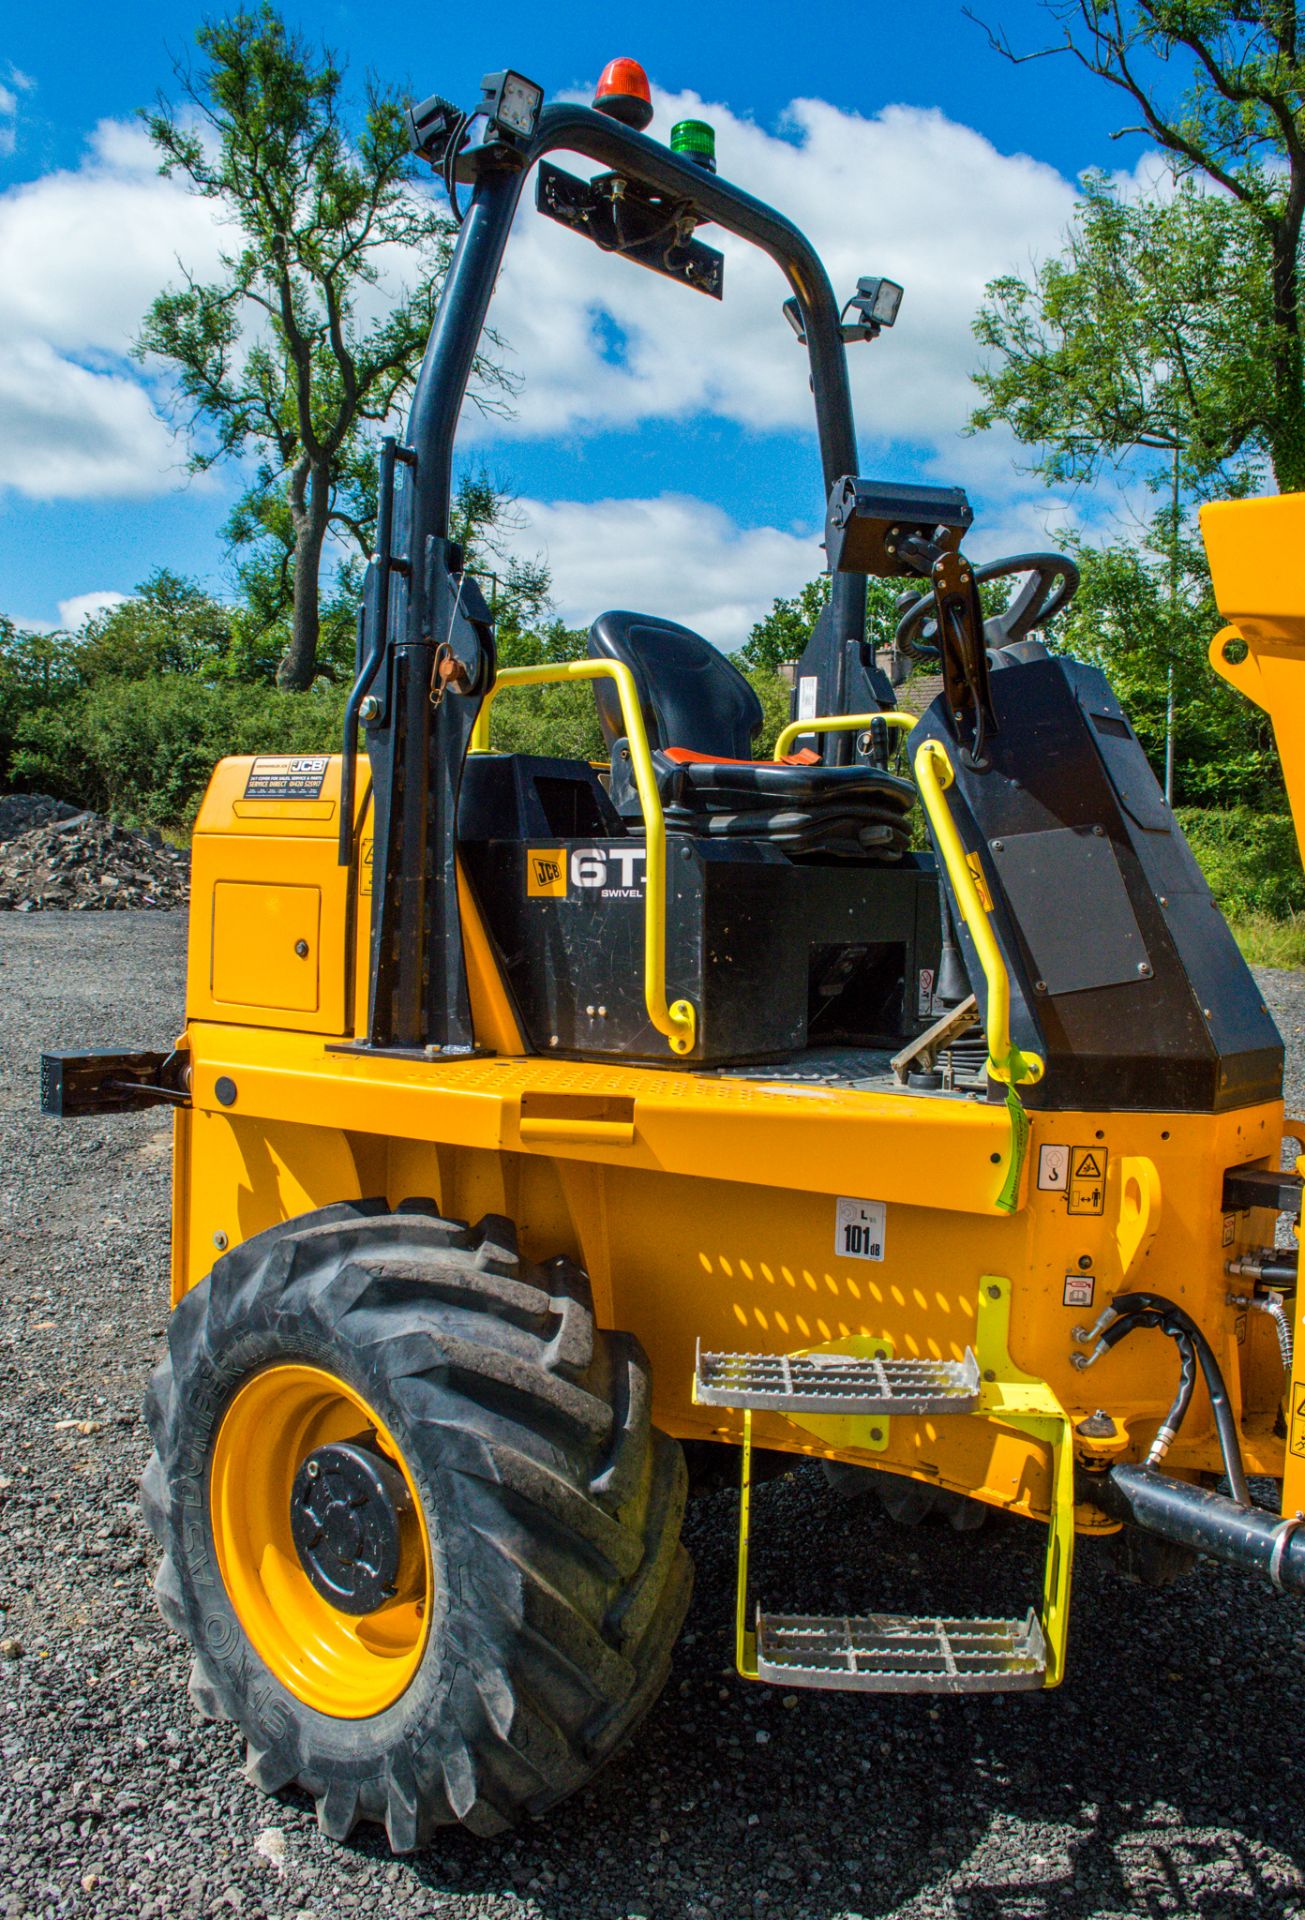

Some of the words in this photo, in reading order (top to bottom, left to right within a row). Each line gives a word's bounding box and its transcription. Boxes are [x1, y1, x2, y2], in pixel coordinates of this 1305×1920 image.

[291, 760, 323, 772] JCB
[538, 861, 560, 884] JCB
[601, 889, 643, 898] SWIVEL
